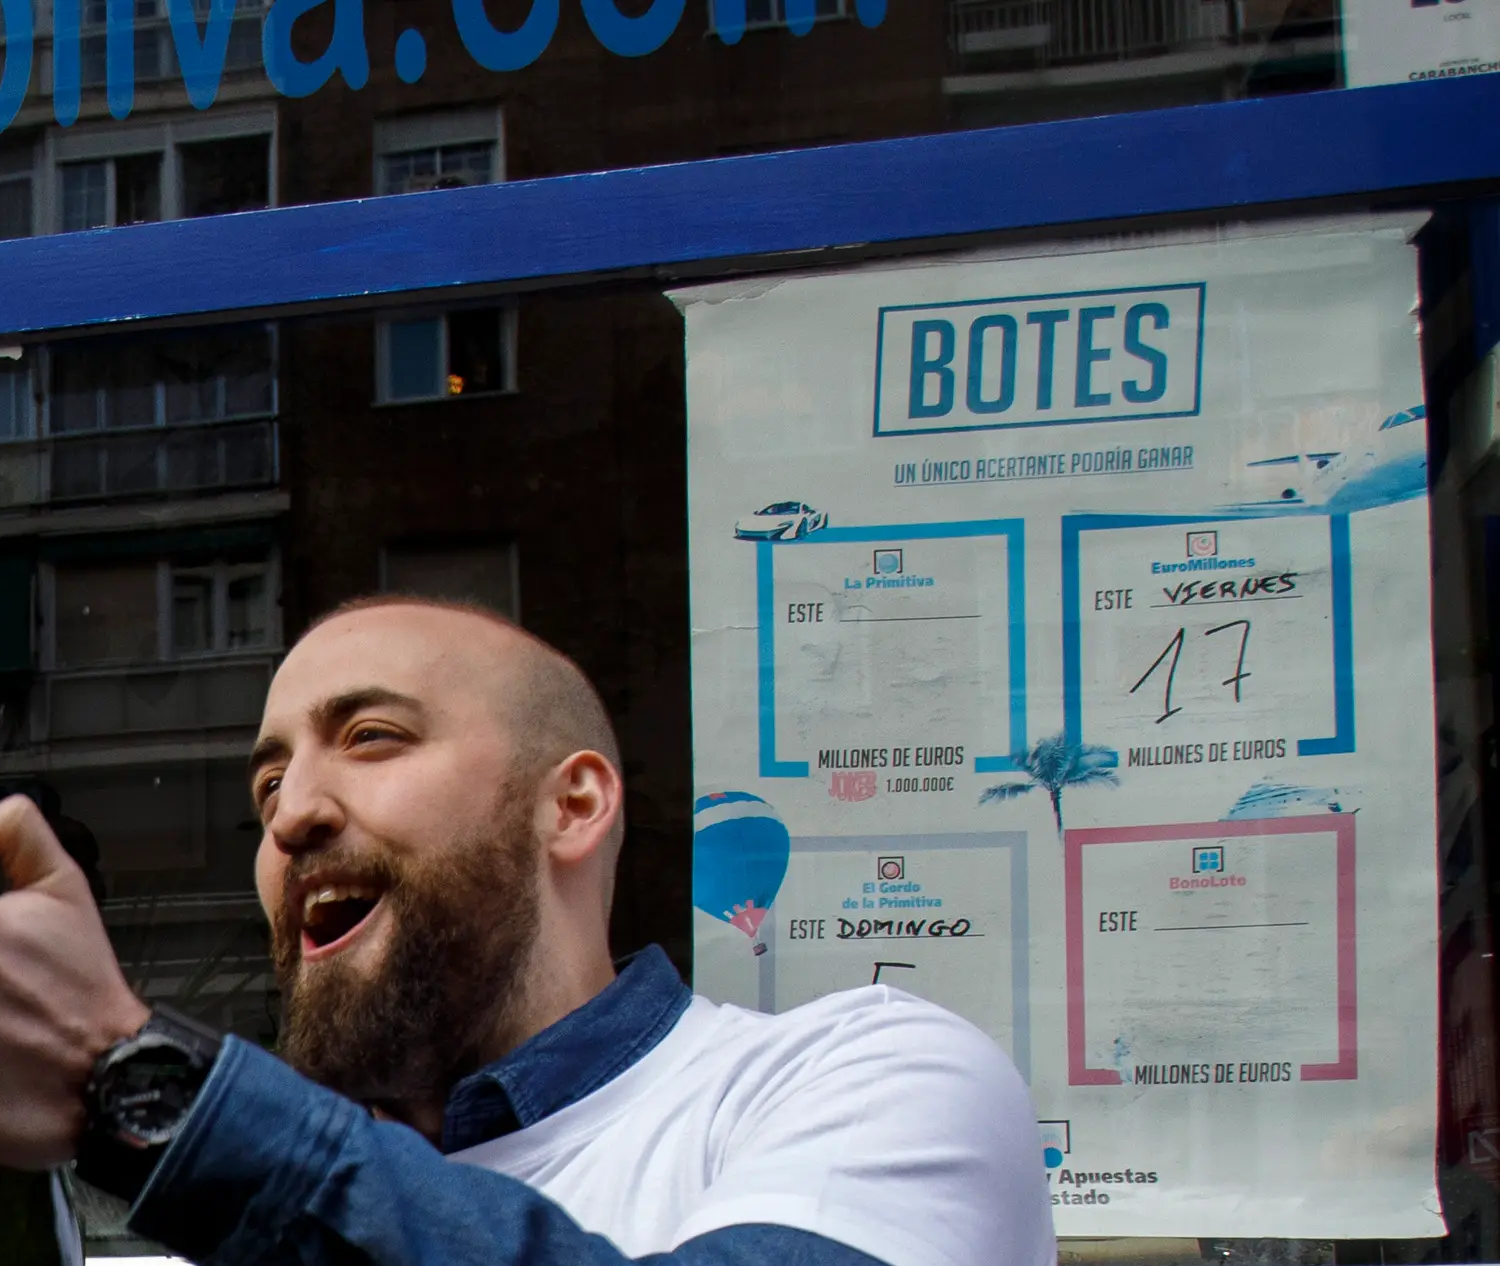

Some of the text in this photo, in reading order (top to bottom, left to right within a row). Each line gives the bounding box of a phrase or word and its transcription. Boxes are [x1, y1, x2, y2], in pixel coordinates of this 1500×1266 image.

[1409, 61, 1500, 80] CARABANCH
[908, 302, 1170, 419] BOTES
[894, 446, 1194, 484] UN ÚNICO ACERTANTE PODRÍA GANAR
[1152, 557, 1256, 574] EuroMillones
[844, 575, 934, 589] La Primitiva
[1163, 573, 1298, 605] VIERNES
[1095, 589, 1133, 611] ESTE
[788, 603, 824, 623] ESTE
[1130, 620, 1251, 723] 17
[818, 745, 964, 768] MILLONES DE EUROS
[1128, 738, 1286, 767] MILLONES DE EUROS
[887, 777, 954, 792] 1.000.000€
[862, 881, 921, 893] El Gordo
[1169, 875, 1247, 889] BonoLoto
[842, 895, 943, 909] de la Primitiva
[789, 919, 825, 939] ESTE
[837, 918, 971, 939] DOMINGO
[1099, 911, 1138, 932] ESTE
[1135, 1062, 1292, 1085] MILLONES DE EUROS
[1058, 1168, 1158, 1187] Apuestas
[1050, 1189, 1110, 1206] stado
